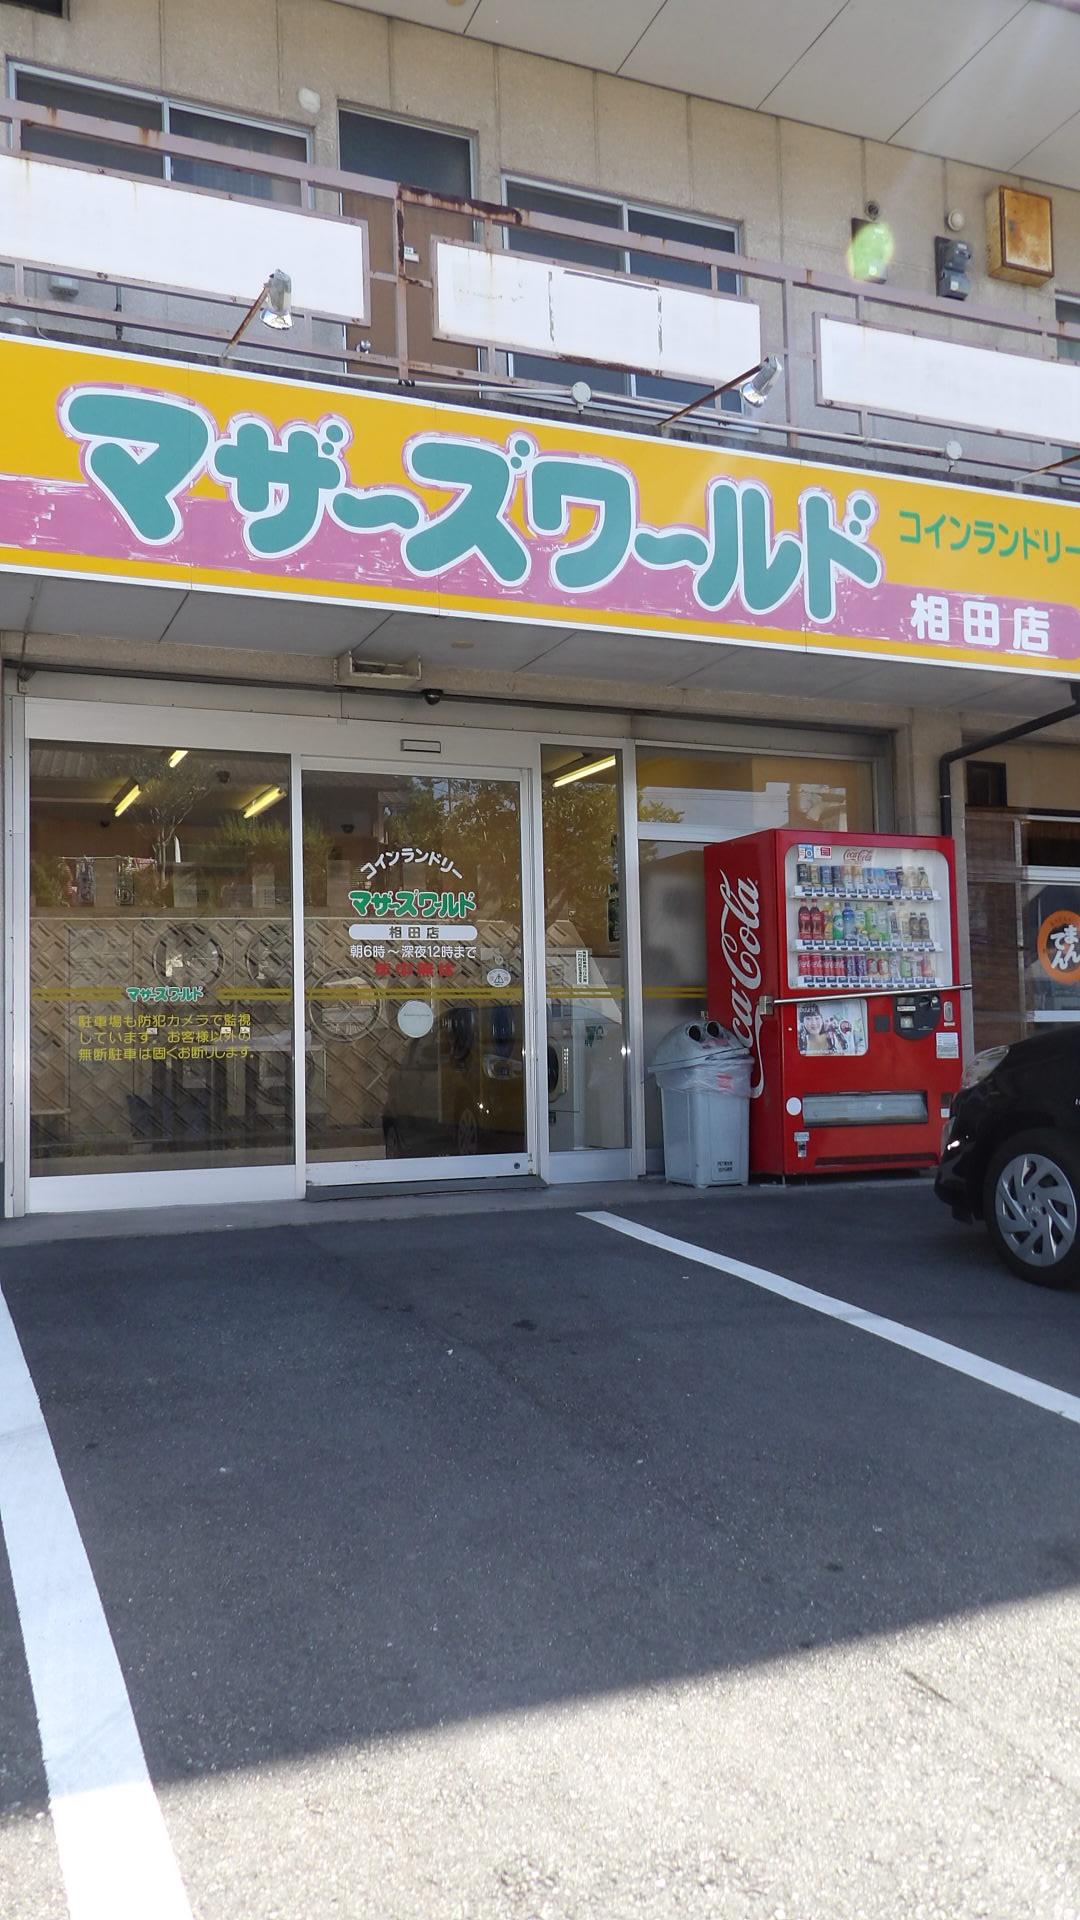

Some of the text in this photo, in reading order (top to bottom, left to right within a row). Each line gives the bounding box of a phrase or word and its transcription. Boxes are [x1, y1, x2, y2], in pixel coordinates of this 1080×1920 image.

[61, 386, 884, 624] マザーズワールド
[899, 509, 1080, 565] コインランドリー
[910, 592, 1051, 653] 相田店
[360, 847, 463, 880] コインランドリー
[348, 889, 477, 918] マザーズワールド
[388, 926, 440, 939] 相田店
[126, 986, 204, 1002] マザーズワールド
[719, 868, 765, 1099] ca-Cola
[78, 1013, 251, 1028] 駐車場も防犯カメラで監視
